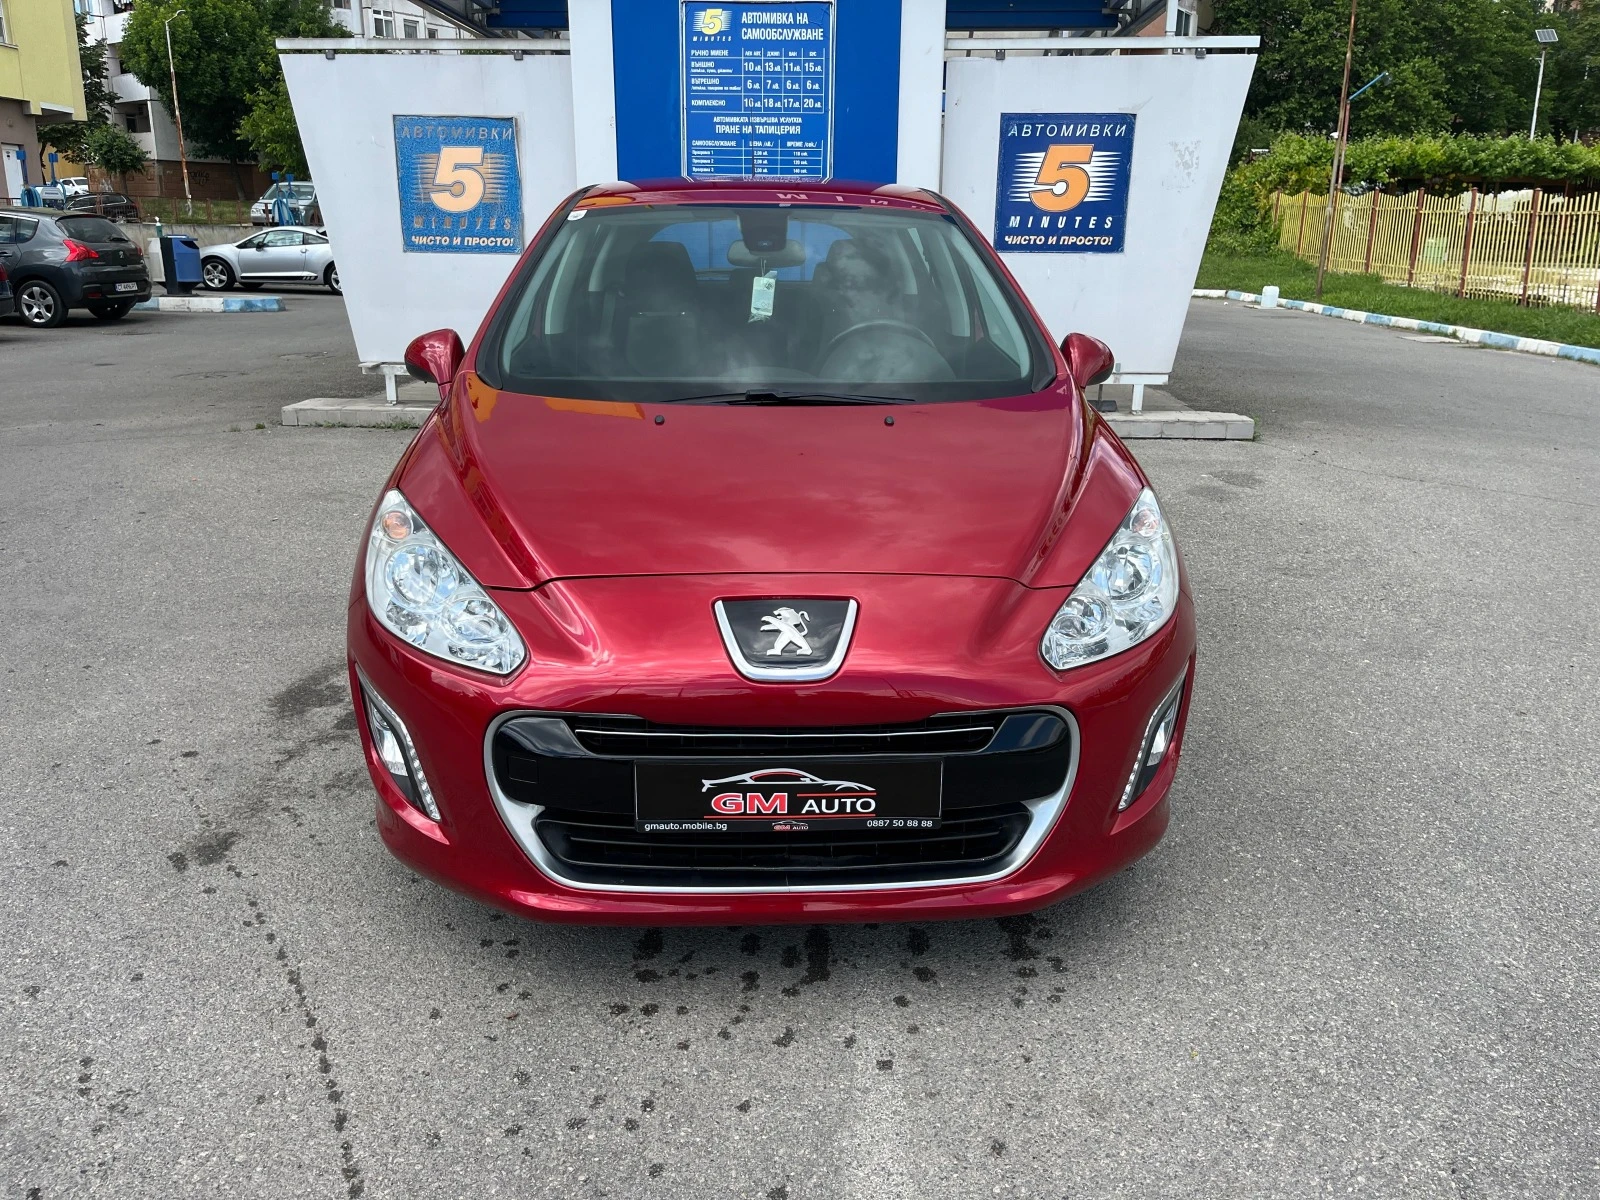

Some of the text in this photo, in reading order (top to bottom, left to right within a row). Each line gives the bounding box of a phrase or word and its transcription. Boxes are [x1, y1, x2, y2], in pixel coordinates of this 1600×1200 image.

[701, 8, 723, 36] 5
[741, 11, 809, 25] АВТОМИВКА НА
[741, 27, 824, 40] САМООБСЛУЖВАНЕ
[690, 49, 729, 57] РЪЧНО МИЕНЕ
[743, 61, 754, 72] 10
[764, 61, 774, 72] 13
[784, 62, 794, 72] 11
[804, 62, 815, 72] 15
[691, 77, 720, 85] ВЪТРЕШНО
[747, 79, 753, 89] 6
[766, 80, 772, 90] 7
[786, 80, 792, 90] 6
[806, 80, 812, 90] 6
[691, 99, 726, 107] КОМПЛЕКСНО
[763, 98, 774, 108] 18
[783, 98, 793, 108] 17
[803, 98, 814, 108] 20
[401, 125, 512, 140] АВТОМИВКИ
[715, 124, 801, 136] ПРАНЕ НА ТАПИЦЕРИЯ
[1007, 123, 1127, 137] АВТОМИВКИ
[429, 145, 486, 213] 5
[1028, 143, 1095, 213] 5
[413, 215, 511, 230] MINUTES
[1008, 215, 1113, 229] MINUTES
[411, 235, 514, 247] ЧИСТО И ПРОСТО!
[1004, 235, 1114, 246] ЧИСТО И ПРОСТО!
[711, 792, 877, 814] GM AUTO
[644, 821, 728, 832] gmauto.mobile.bg
[866, 819, 933, 828] 0887 50 88 88
